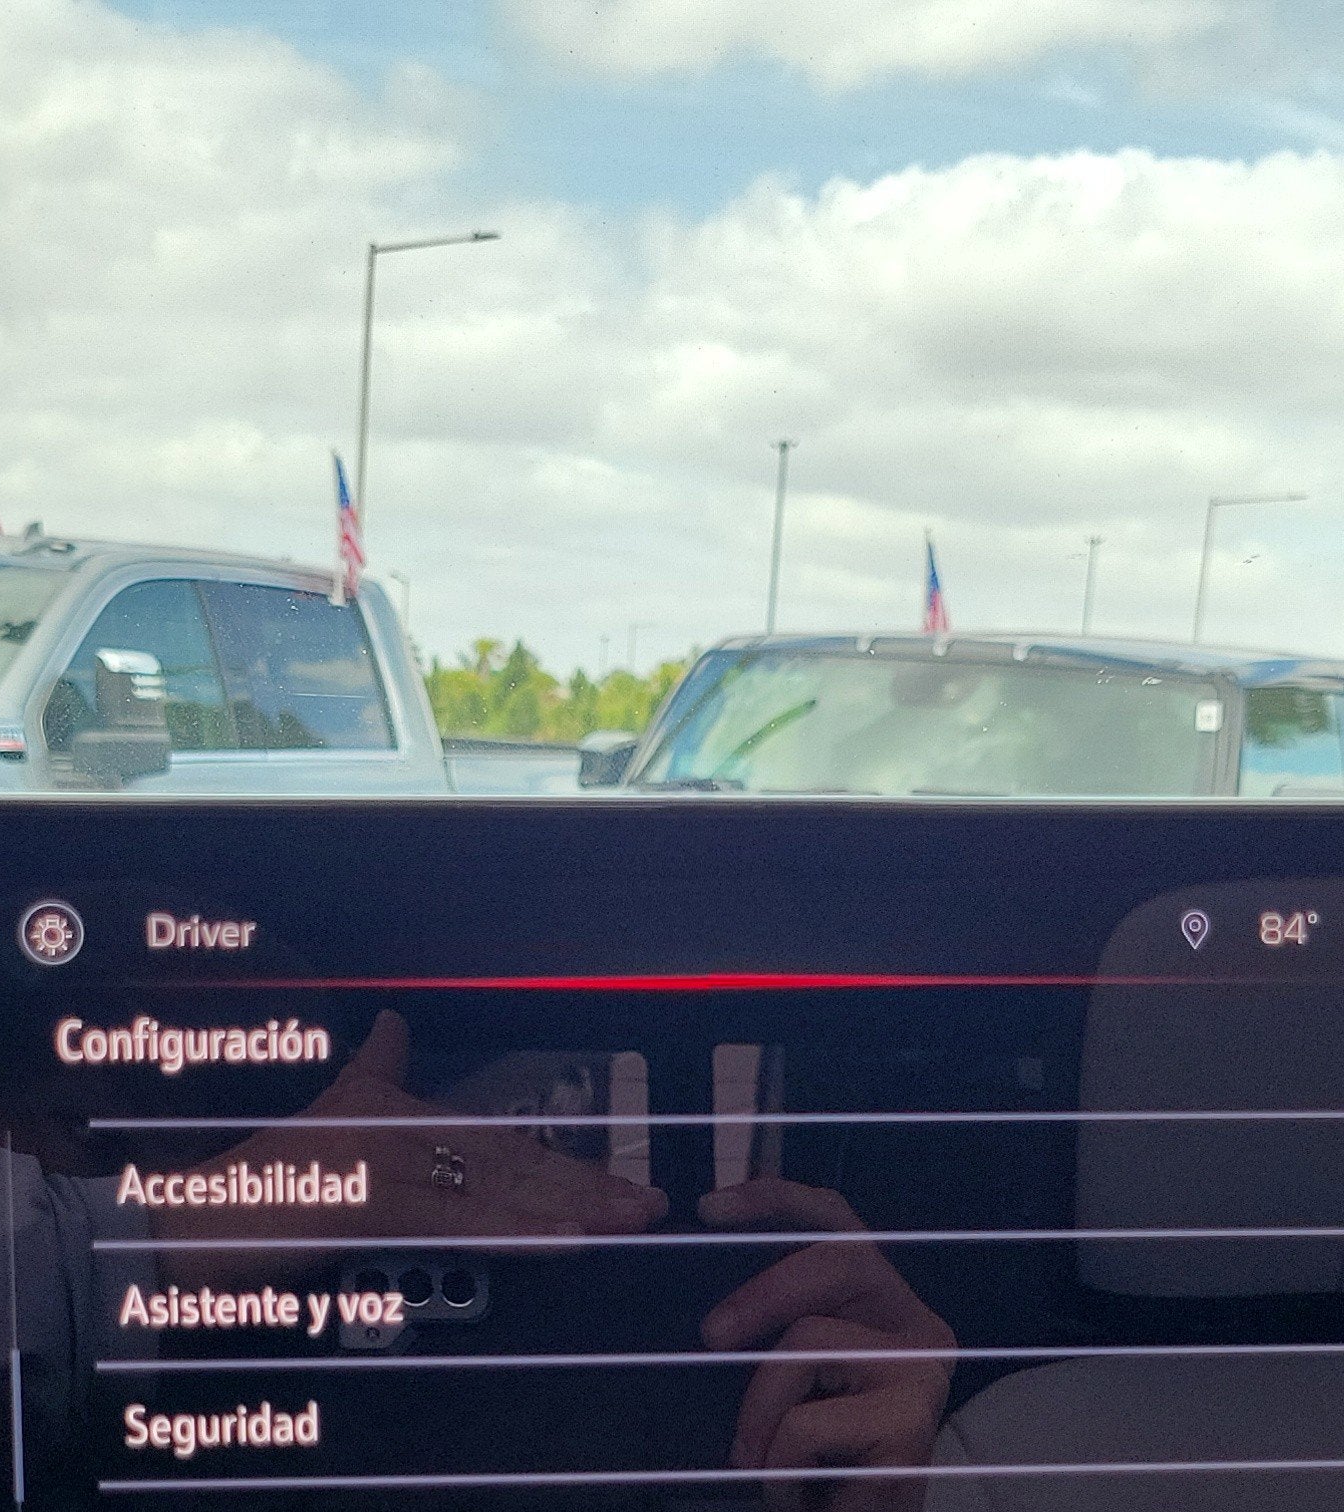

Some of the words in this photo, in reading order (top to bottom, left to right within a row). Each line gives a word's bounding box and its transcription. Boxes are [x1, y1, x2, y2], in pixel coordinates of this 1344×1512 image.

[146, 911, 256, 949] Driver
[1260, 910, 1320, 947] 84°
[56, 1017, 330, 1073] Configuración
[116, 1162, 369, 1206] Accesibilidad
[120, 1284, 299, 1327] Asistente
[309, 1296, 328, 1333] y
[340, 1292, 404, 1324] voz
[124, 1400, 321, 1457] Seguridad
